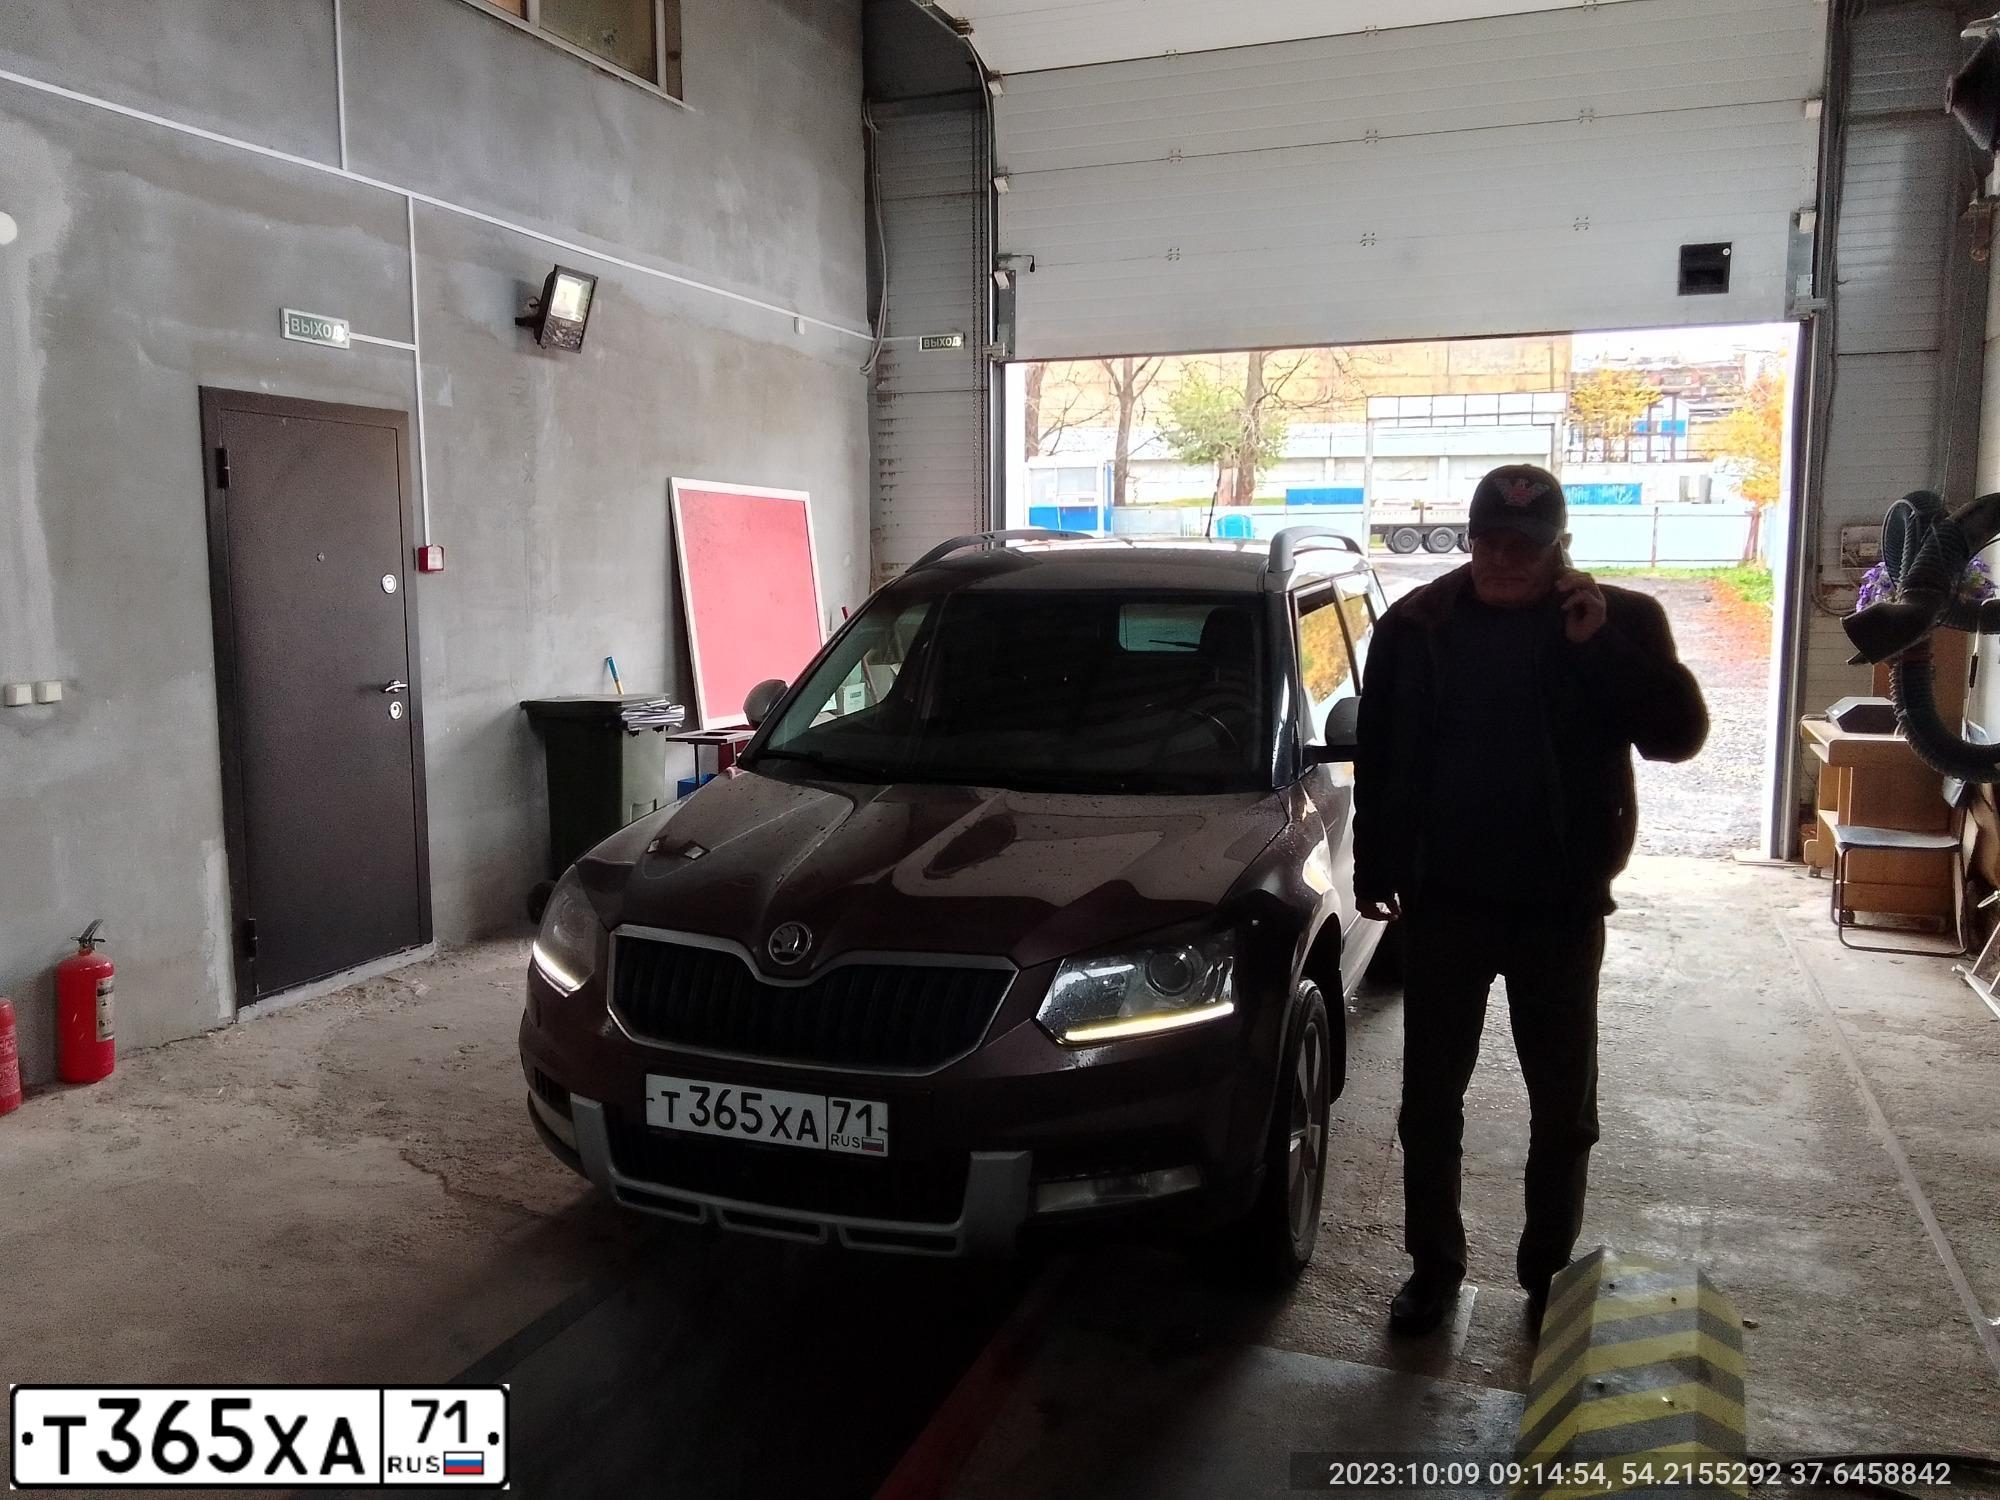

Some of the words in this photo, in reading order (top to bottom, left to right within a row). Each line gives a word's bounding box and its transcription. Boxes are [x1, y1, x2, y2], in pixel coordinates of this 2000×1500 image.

[291, 318, 345, 342] ВЫХОД
[661, 1085, 819, 1143] Т365ХА
[832, 1100, 872, 1137] 71
[830, 1134, 861, 1148] RUS
